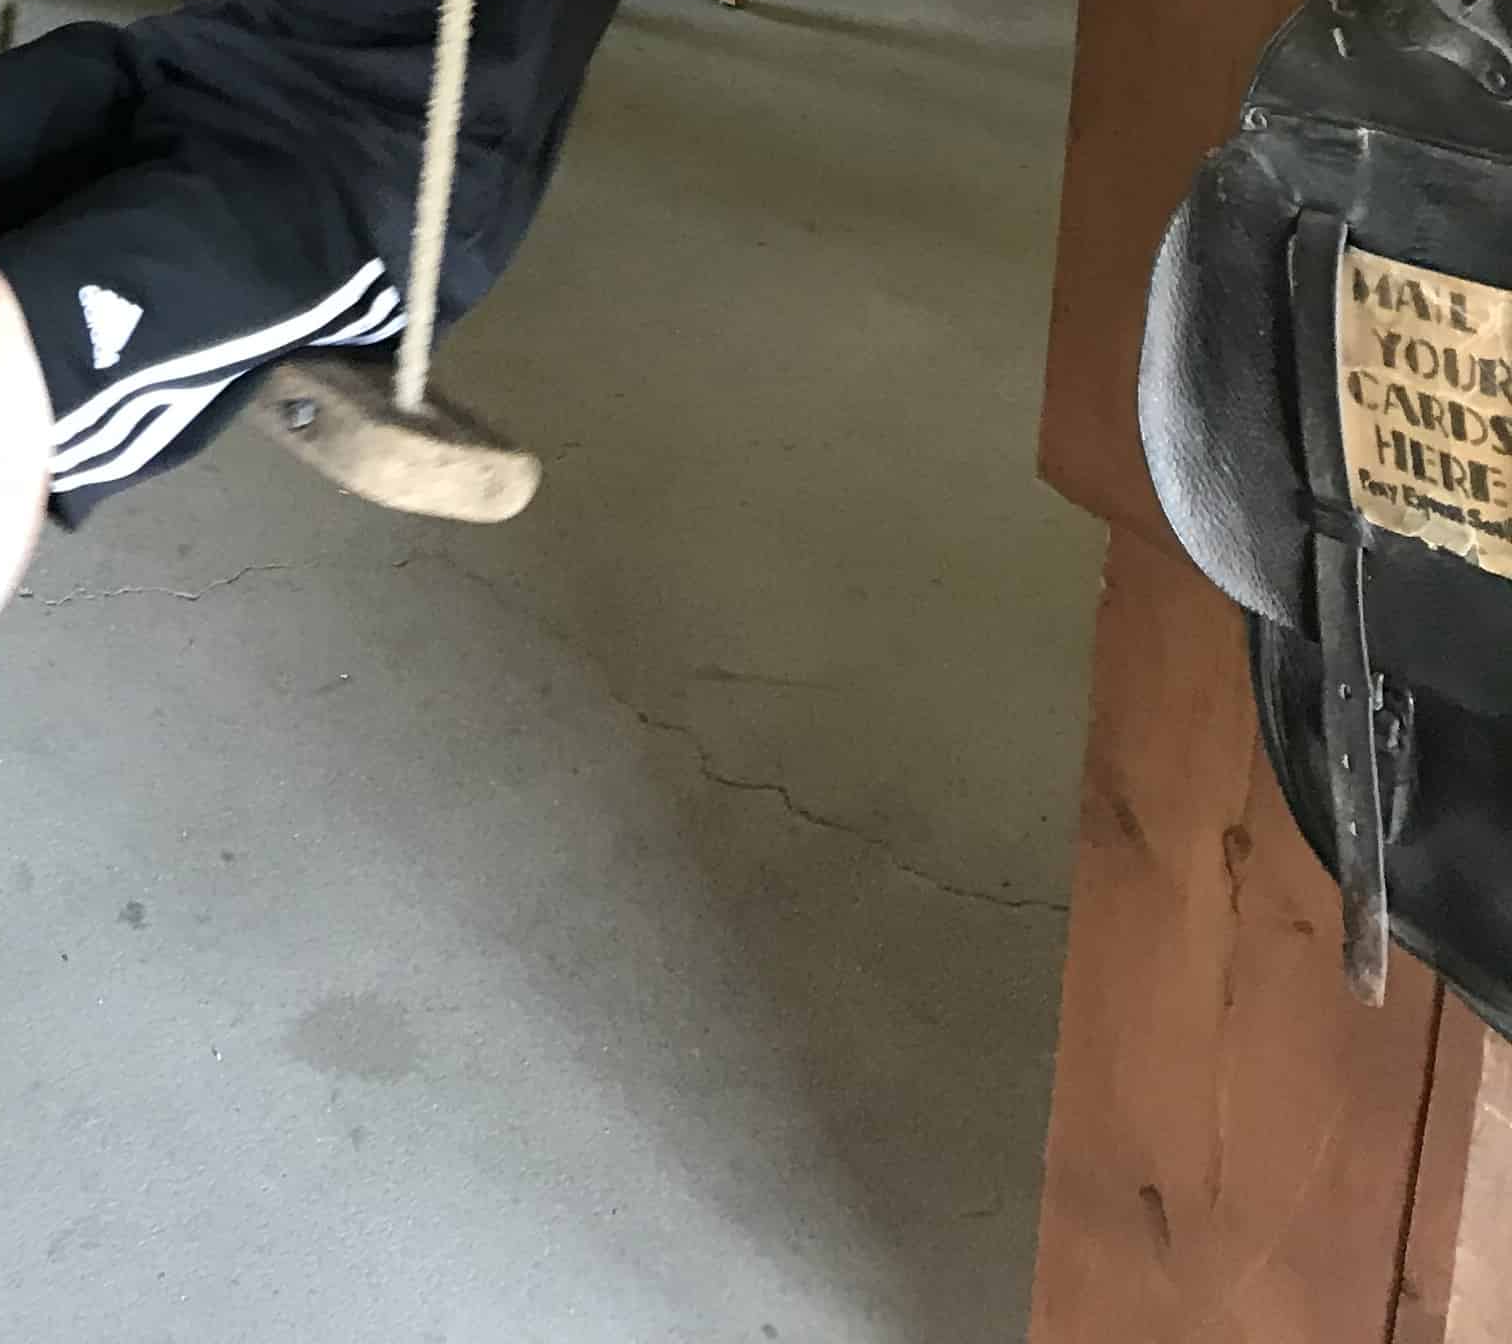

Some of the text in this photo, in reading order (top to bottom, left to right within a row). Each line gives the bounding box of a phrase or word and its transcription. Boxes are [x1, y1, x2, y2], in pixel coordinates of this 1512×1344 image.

[1373, 328, 1512, 405] YOUR
[1347, 370, 1512, 456] CARDS
[1374, 423, 1509, 508] HERE
